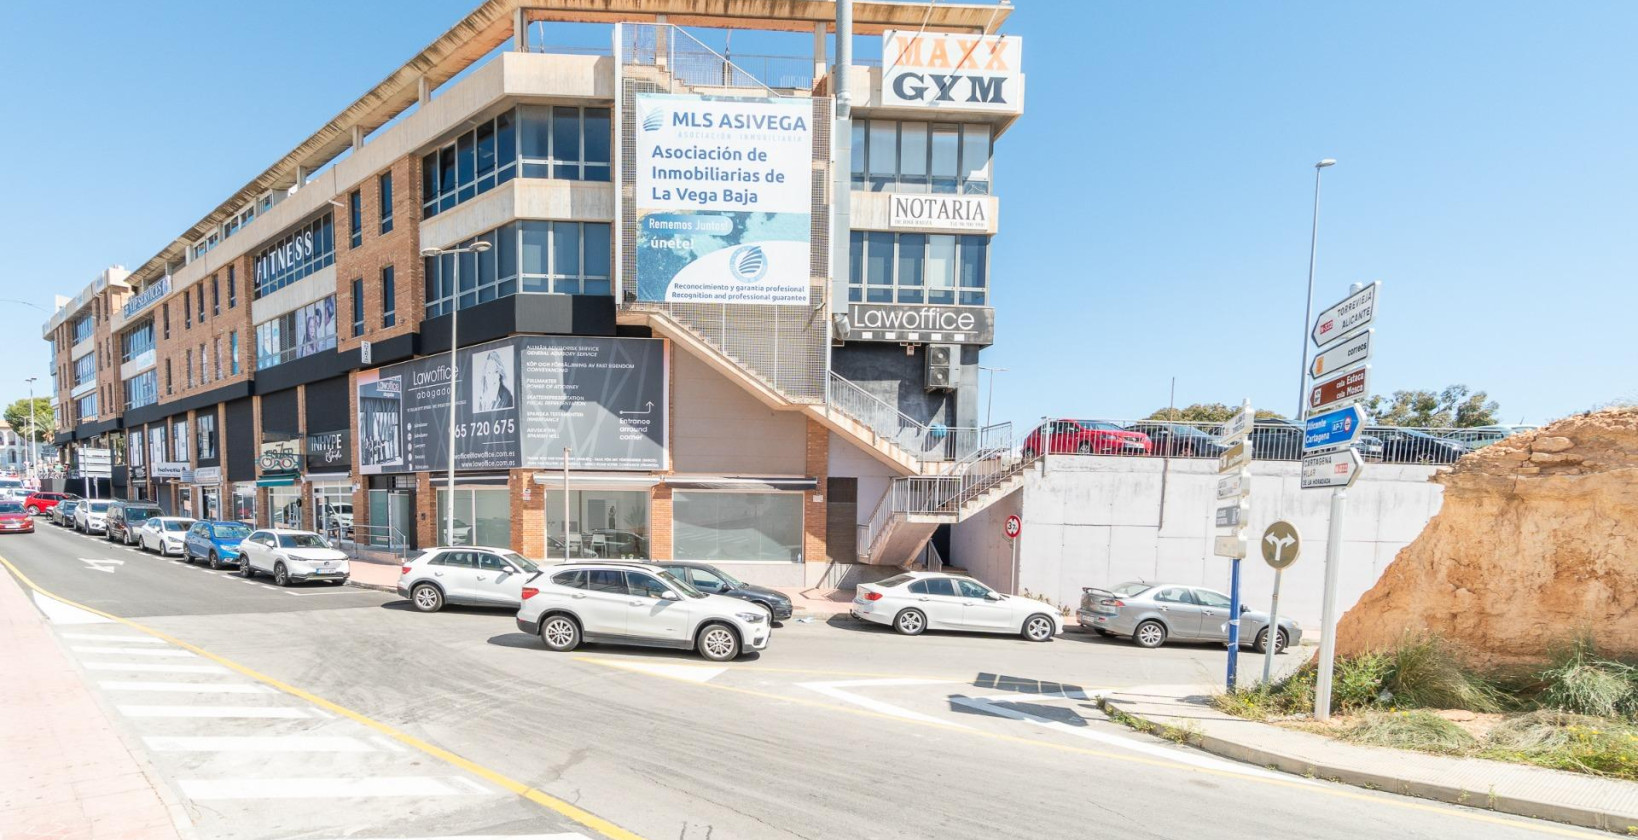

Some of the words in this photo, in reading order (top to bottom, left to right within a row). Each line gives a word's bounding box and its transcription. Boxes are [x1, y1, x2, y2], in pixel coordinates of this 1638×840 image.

[894, 36, 1009, 71] MAXX
[893, 72, 1009, 104] GYM
[672, 111, 713, 128] MLS
[718, 113, 807, 132] ASIVEGA
[652, 145, 742, 161] Asociación
[747, 147, 767, 162] de
[652, 166, 760, 183] Inmobiliarias
[765, 169, 785, 183] de
[652, 187, 671, 200] La
[676, 187, 718, 204] Vega
[723, 189, 758, 206] Baja
[895, 197, 985, 220] NOTARIA
[649, 218, 692, 230] Rememos
[695, 220, 729, 231] Juntos!
[650, 235, 694, 249] únete!
[256, 231, 312, 284] FITNESS
[672, 291, 713, 300] Recognition
[714, 292, 727, 300] and
[728, 292, 770, 302] professional
[772, 294, 807, 302] guarantee
[674, 283, 729, 291] Reconocimiento
[1337, 291, 1372, 317] TORREVIEJA
[854, 306, 975, 329] Lawoffice
[1342, 306, 1371, 329] ALICANTE
[1347, 342, 1367, 357] correos
[413, 364, 459, 386] Lawoffice
[417, 387, 452, 399] abogado
[448, 423, 467, 439] 65
[470, 421, 490, 437] 720
[493, 419, 515, 435] 675
[1307, 419, 1327, 431] Alicante
[1332, 422, 1343, 431] AP-7
[311, 433, 342, 452] INHYPE
[1305, 432, 1330, 444] Cartagena
[1304, 456, 1332, 467] CARTAGENA
